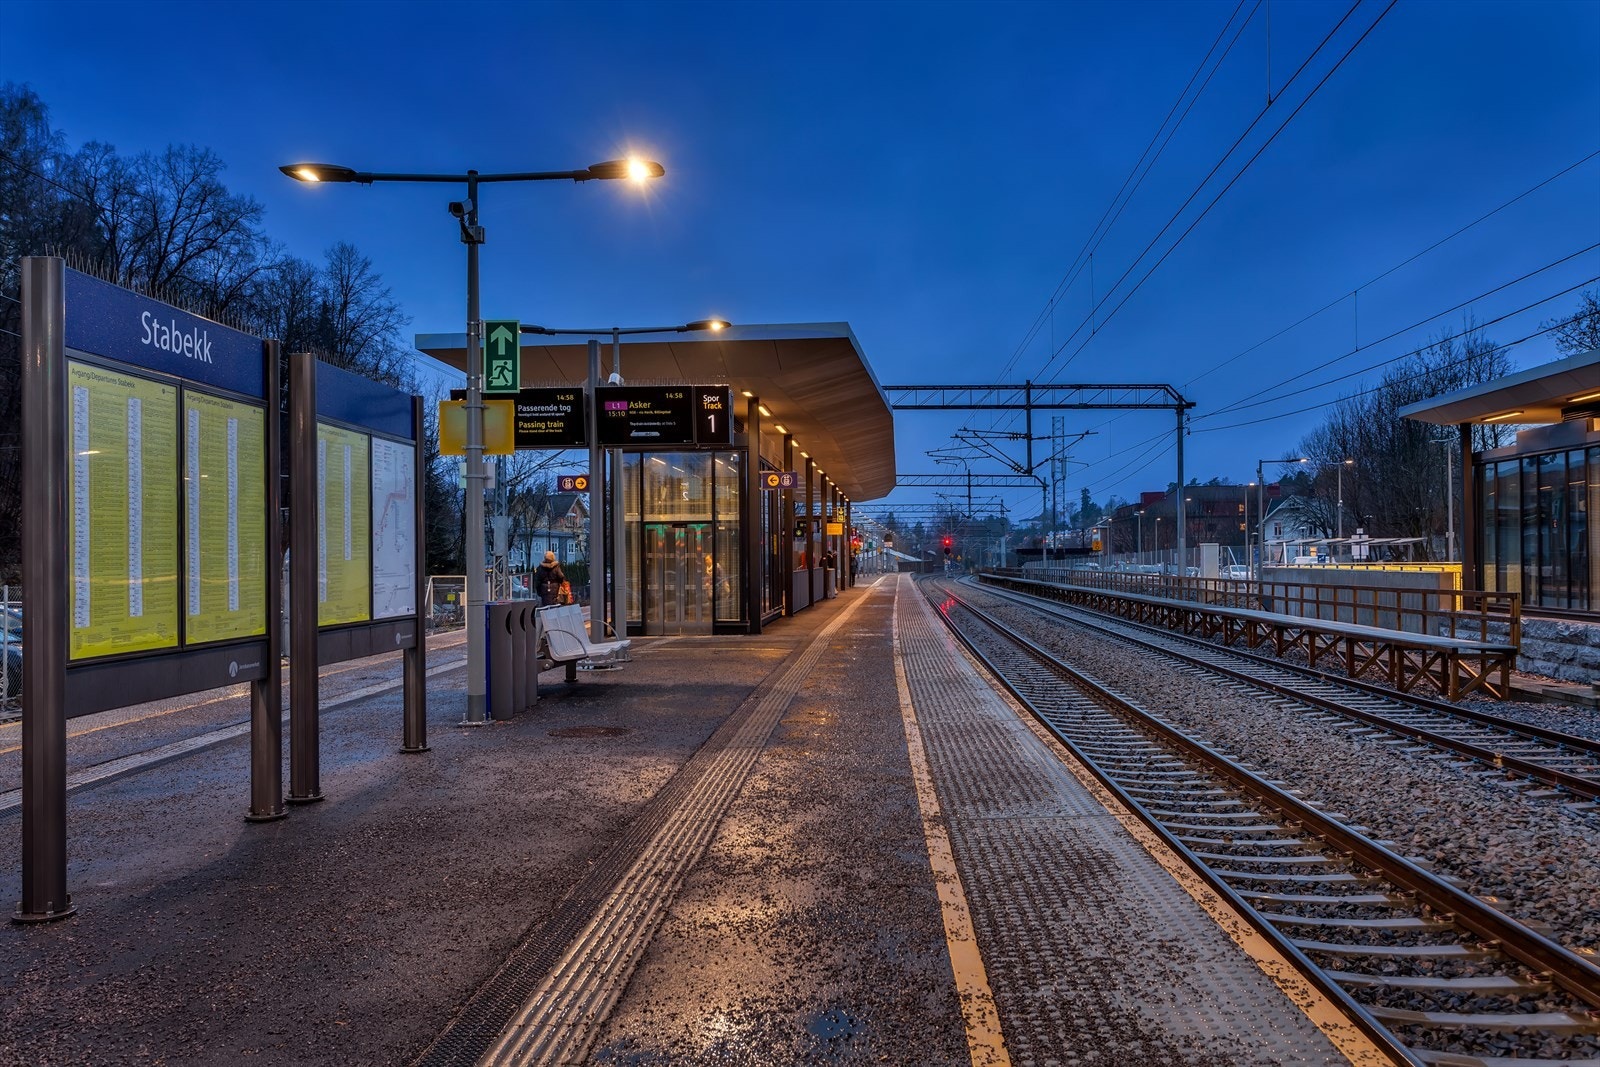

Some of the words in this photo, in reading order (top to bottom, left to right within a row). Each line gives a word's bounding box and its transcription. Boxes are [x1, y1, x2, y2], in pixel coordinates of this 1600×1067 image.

[140, 310, 213, 364] Stabekk
[117, 377, 136, 389] Stabekk
[702, 394, 720, 403] Spor
[559, 404, 571, 412] tog
[629, 400, 651, 409] Asker
[702, 402, 722, 410] Track
[518, 420, 546, 429] Passing
[707, 414, 716, 433] 1
